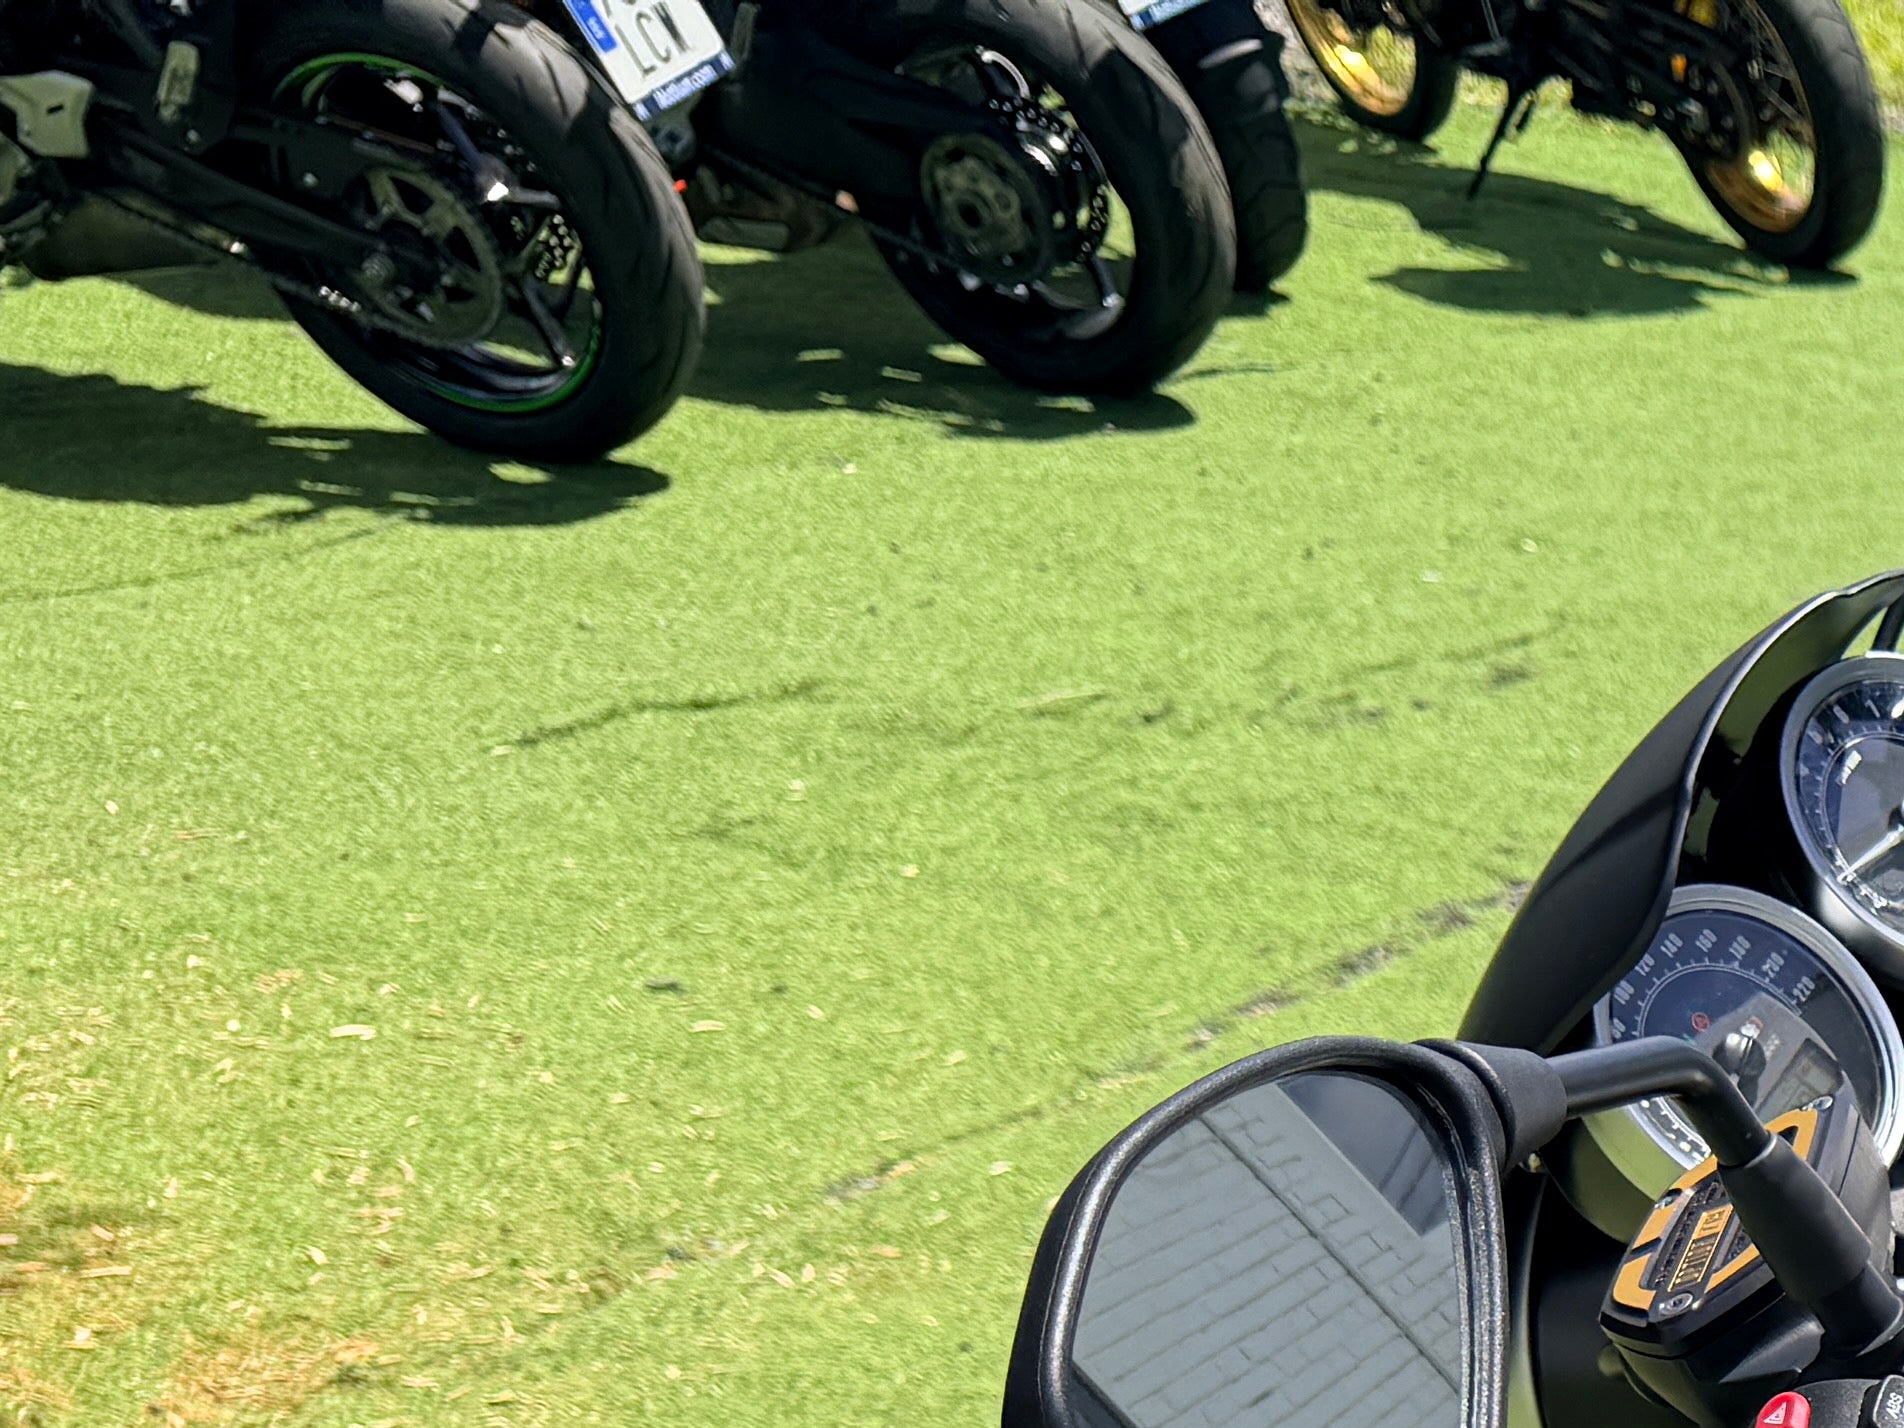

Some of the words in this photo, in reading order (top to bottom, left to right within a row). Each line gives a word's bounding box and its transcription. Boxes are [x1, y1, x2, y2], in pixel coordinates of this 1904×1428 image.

[1660, 932, 1683, 958] 140
[1695, 928, 1718, 952] 160
[1729, 935, 1751, 960] 180
[1634, 953, 1655, 977] 120
[1614, 980, 1635, 1005] 100
[1792, 976, 1816, 1003] 220
[1885, 1393, 1904, 1420] ABS
